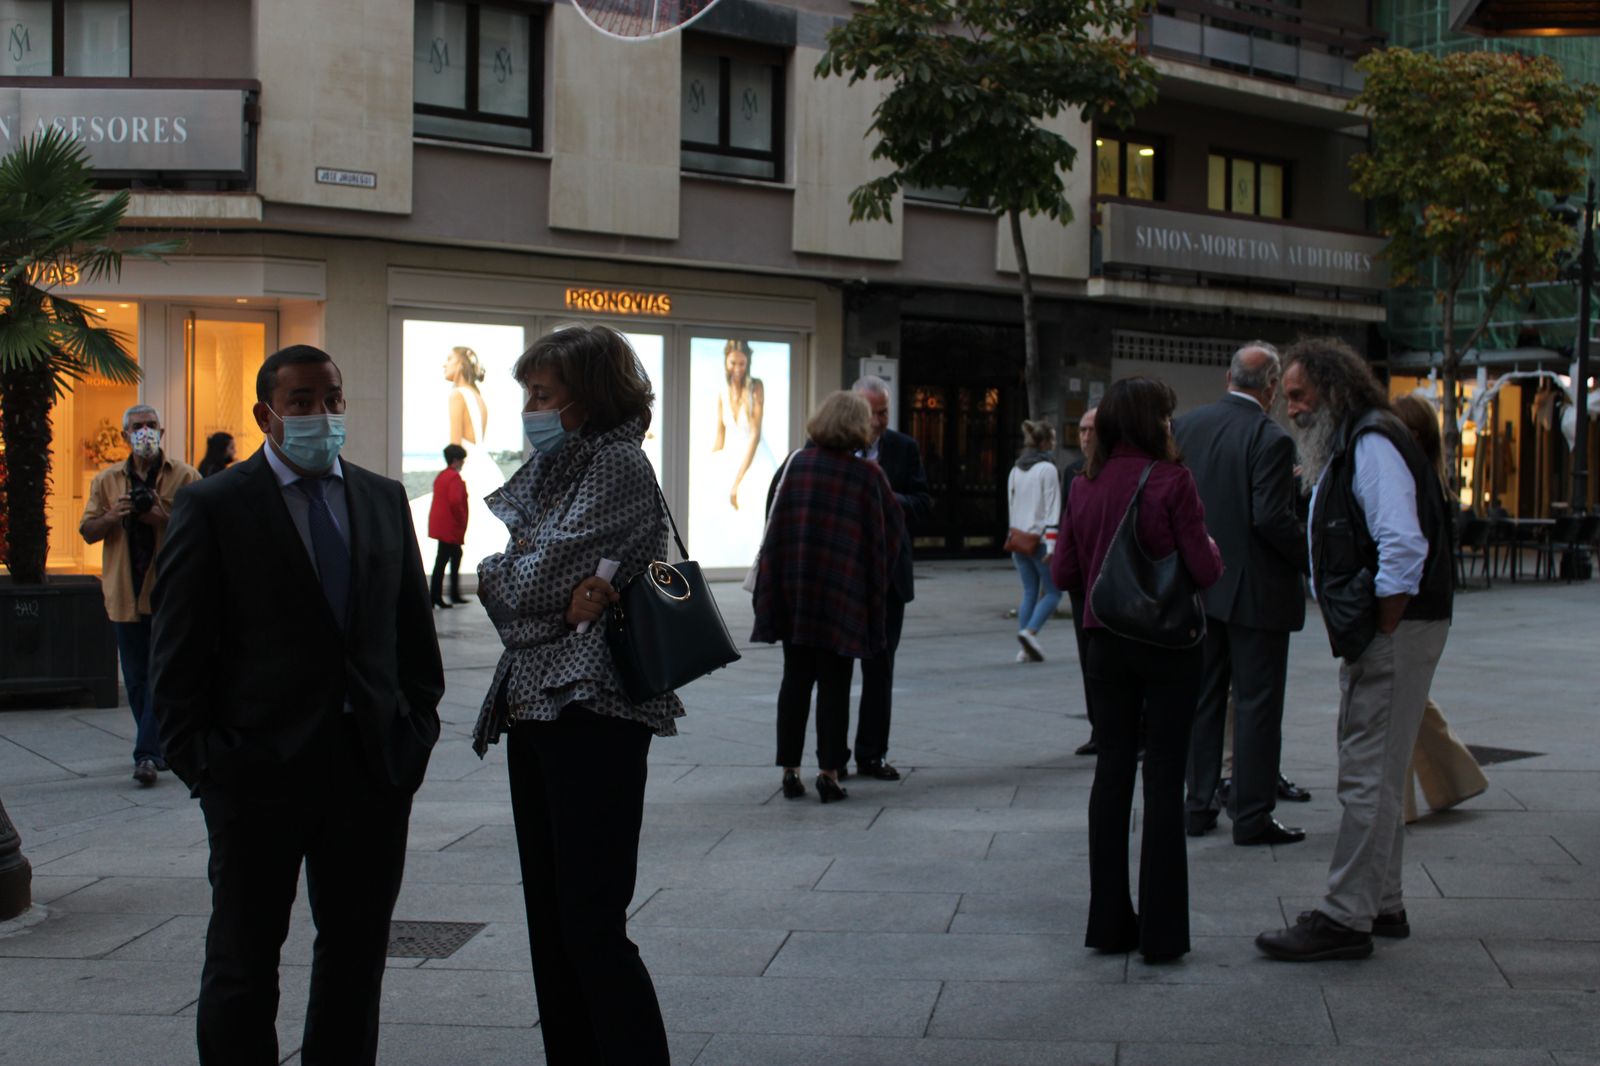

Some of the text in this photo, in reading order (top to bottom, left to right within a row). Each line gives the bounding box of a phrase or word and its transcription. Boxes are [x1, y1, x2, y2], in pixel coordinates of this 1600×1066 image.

[36, 115, 188, 144] ASESORES
[1289, 245, 1371, 273] AUDITORES
[564, 287, 672, 316] PRONOVIAS
